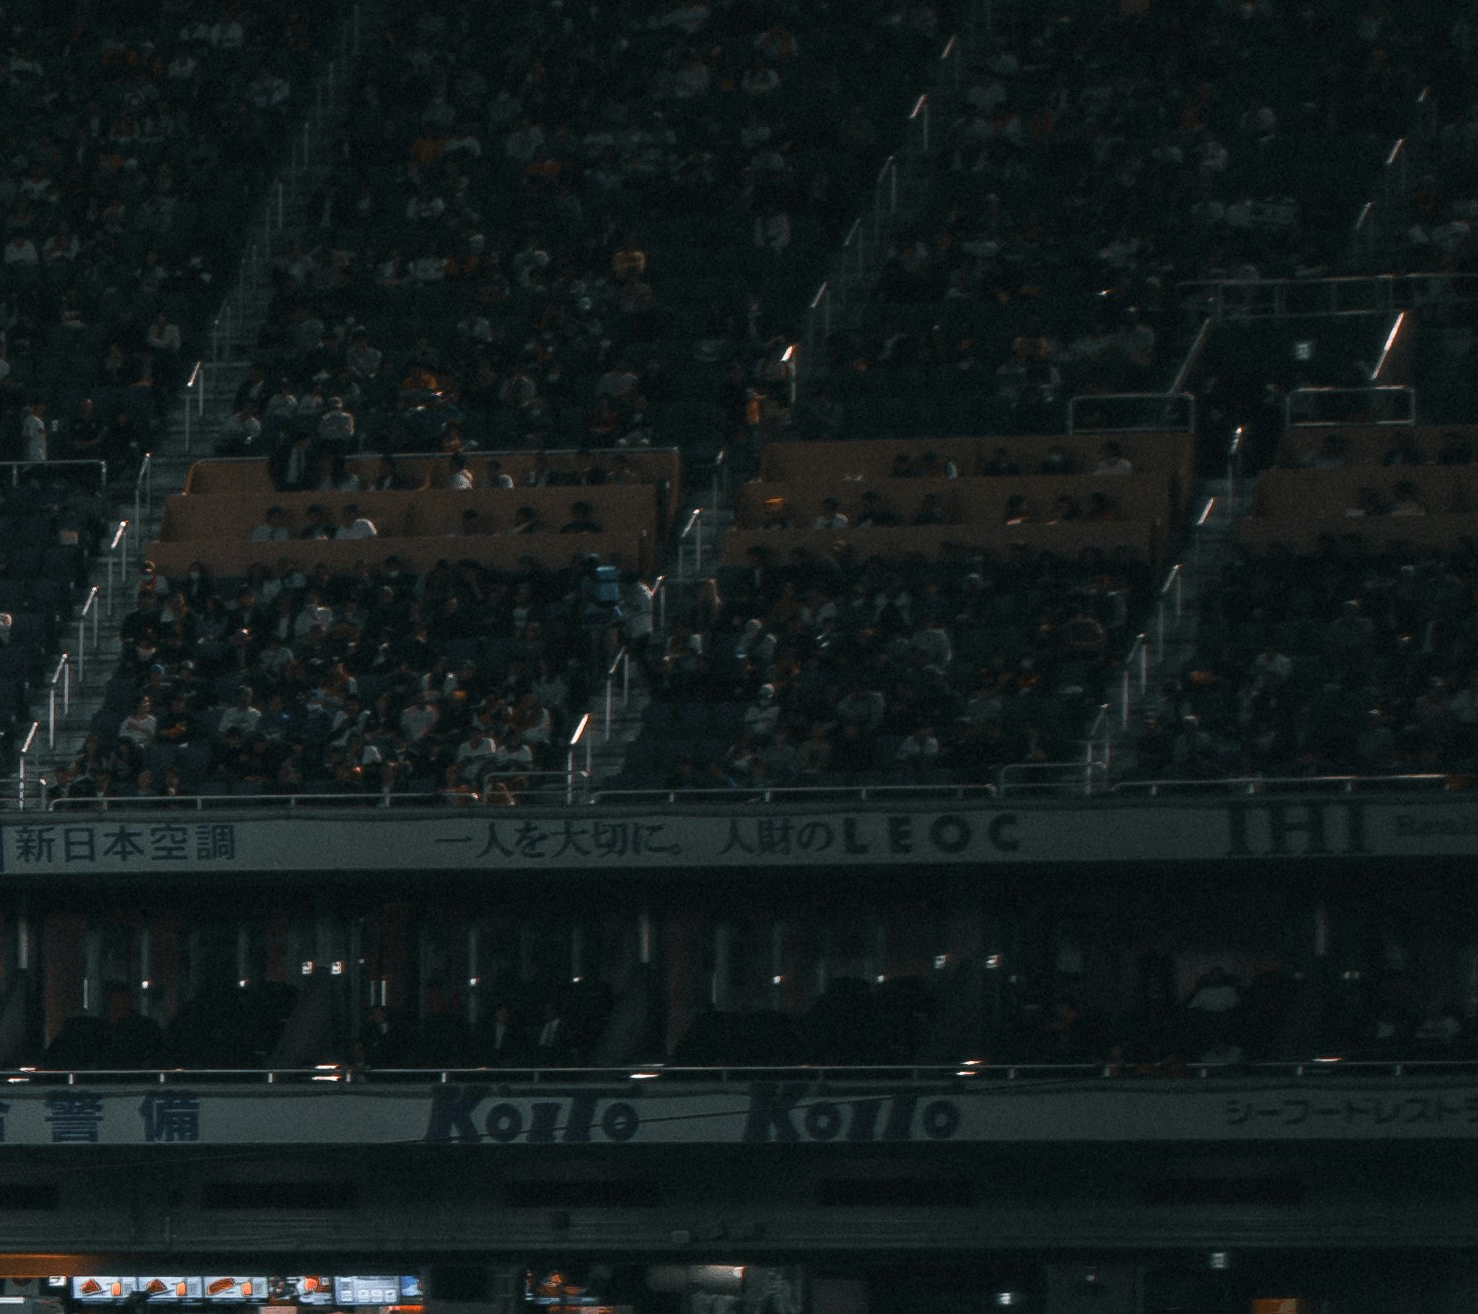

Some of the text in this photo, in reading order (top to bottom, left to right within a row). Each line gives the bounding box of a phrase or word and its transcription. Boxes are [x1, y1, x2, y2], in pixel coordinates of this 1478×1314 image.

[15, 825, 235, 864] 新日本空調
[434, 821, 683, 858] 一人を大切に。
[1226, 800, 1374, 855] IHI
